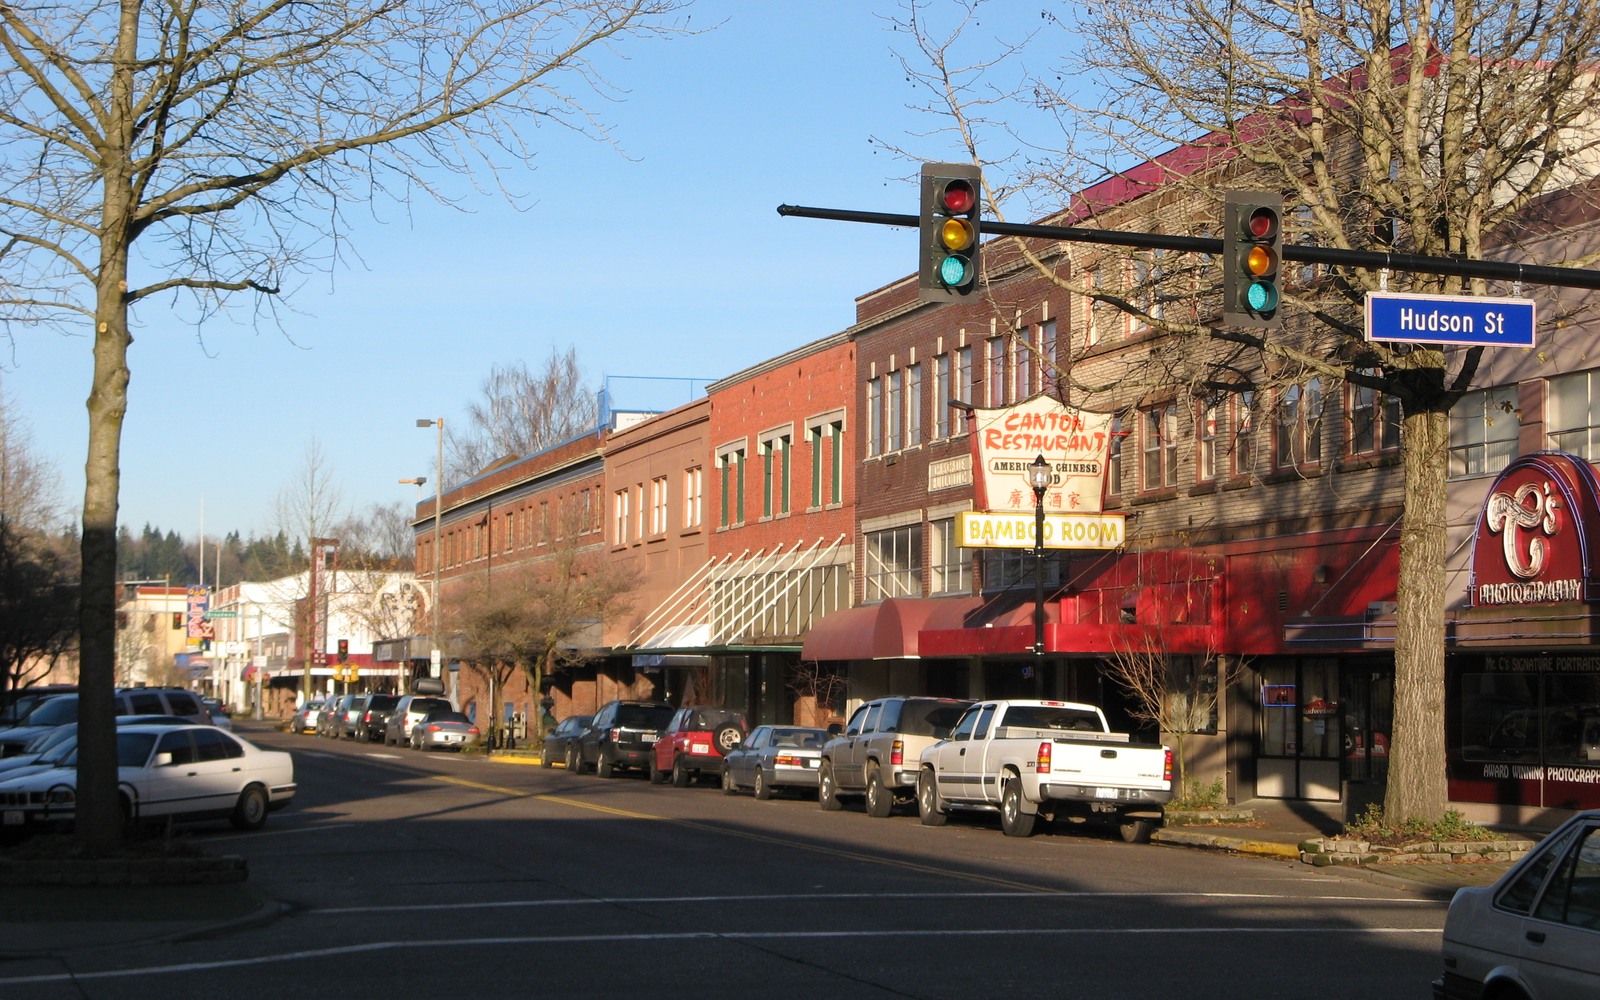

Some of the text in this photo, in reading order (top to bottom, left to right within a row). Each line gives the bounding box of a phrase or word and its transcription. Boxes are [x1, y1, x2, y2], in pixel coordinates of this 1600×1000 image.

[1401, 308, 1504, 334] Hudson St
[1005, 413, 1086, 432] CANTON
[985, 428, 1106, 451] RESTAURANT
[994, 462, 1031, 471] AMERIC
[1056, 463, 1097, 472] CHINESE
[932, 472, 967, 489] BUILDING
[1061, 521, 1118, 541] ROOM
[1479, 579, 1582, 603] PHOTOGRAPHY
[1512, 658, 1553, 671] SIGNATURE
[1556, 657, 1600, 671] PORTRAITS
[1484, 764, 1509, 778] AWARD
[1513, 765, 1544, 780] WINNING
